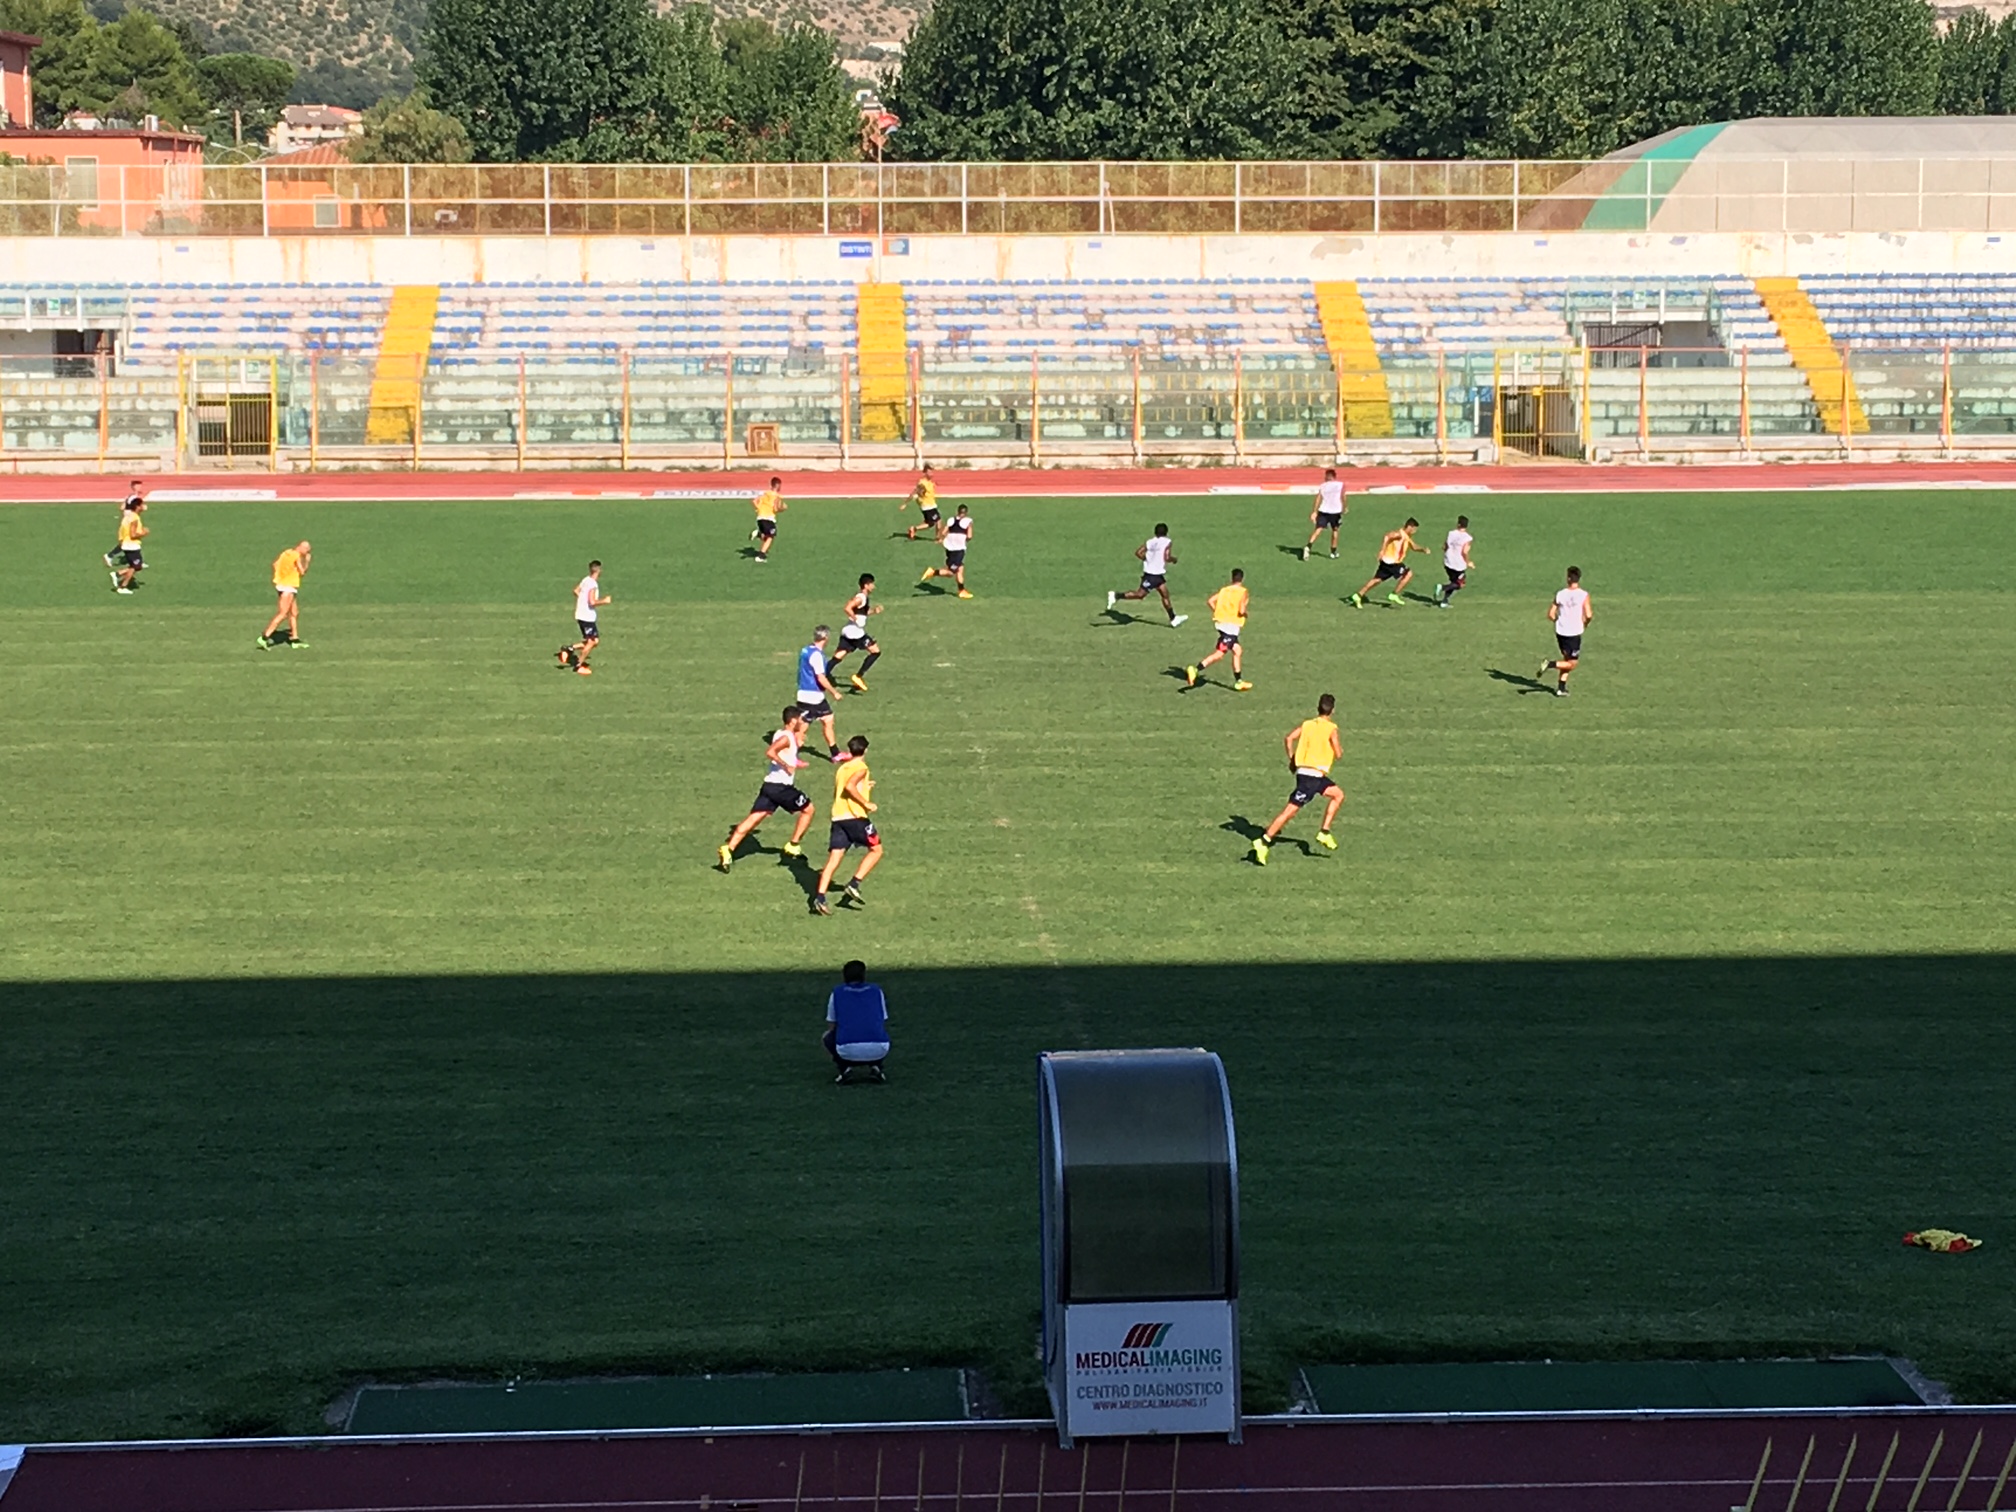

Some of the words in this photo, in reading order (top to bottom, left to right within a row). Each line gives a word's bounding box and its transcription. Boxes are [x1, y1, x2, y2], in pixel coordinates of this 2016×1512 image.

[1076, 1348, 1222, 1369] MEDICALIMAGING
[1076, 1384, 1130, 1399] CENTRO
[1133, 1382, 1223, 1397] DIAGNOSTICO
[1092, 1399, 1208, 1411] WWW.MEDICALIMAGING.IT
